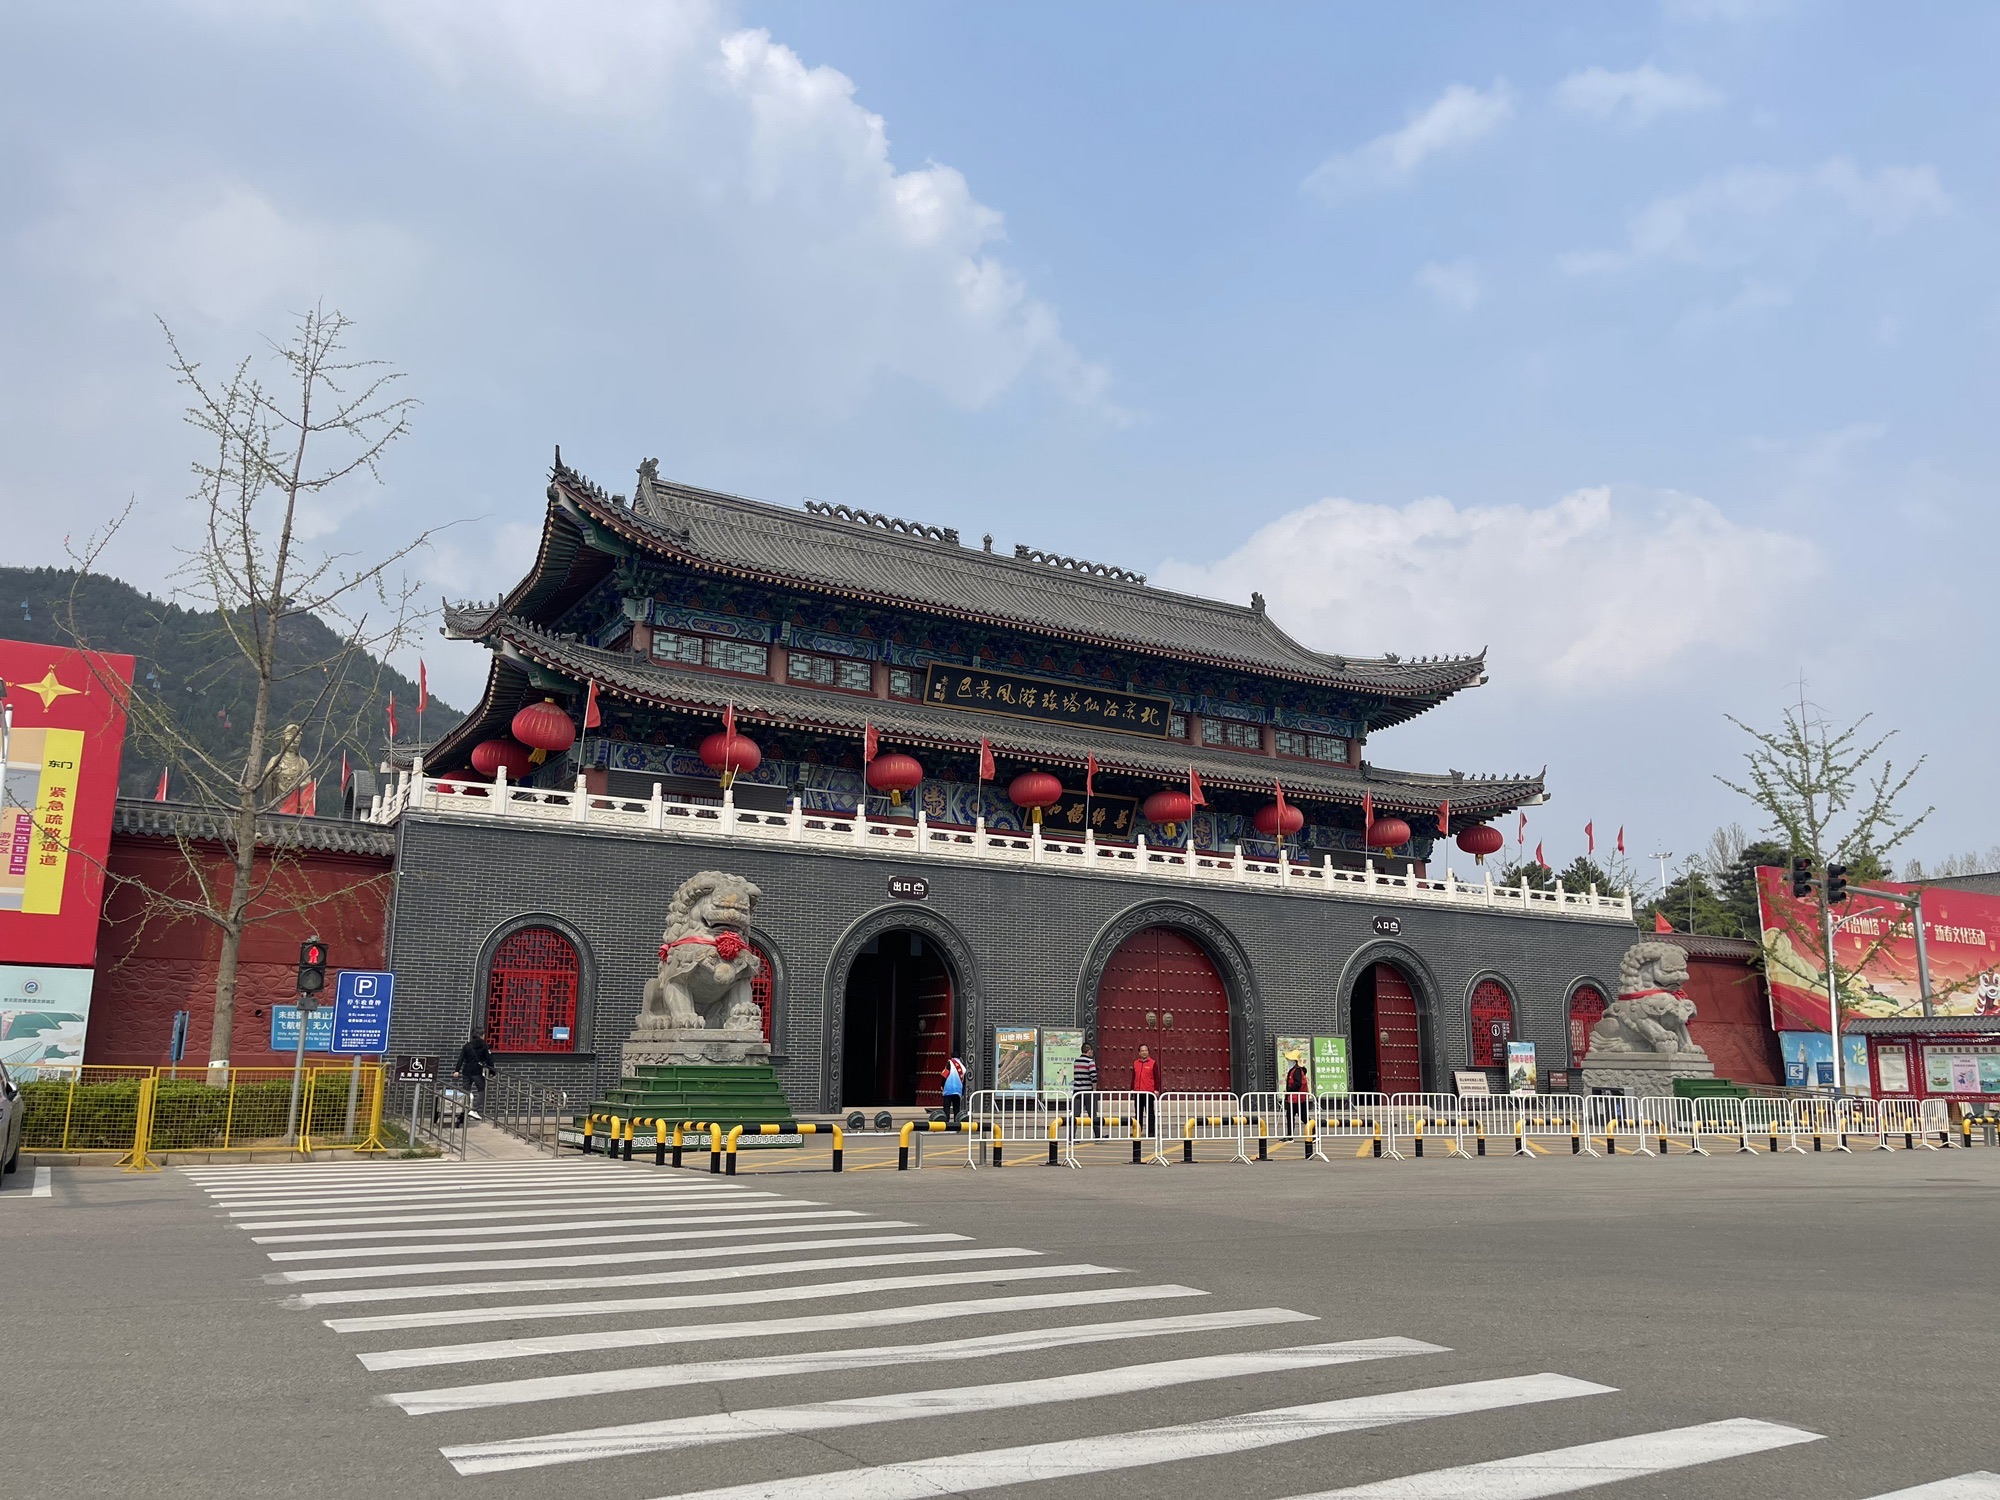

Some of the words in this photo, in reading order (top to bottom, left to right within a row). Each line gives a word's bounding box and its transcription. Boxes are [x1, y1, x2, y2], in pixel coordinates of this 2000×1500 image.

[48, 760, 73, 770] 东门
[39, 787, 67, 866] 紧急疏散通道
[893, 881, 911, 892] 出口
[1376, 921, 1390, 929] 入口
[358, 979, 373, 994] P
